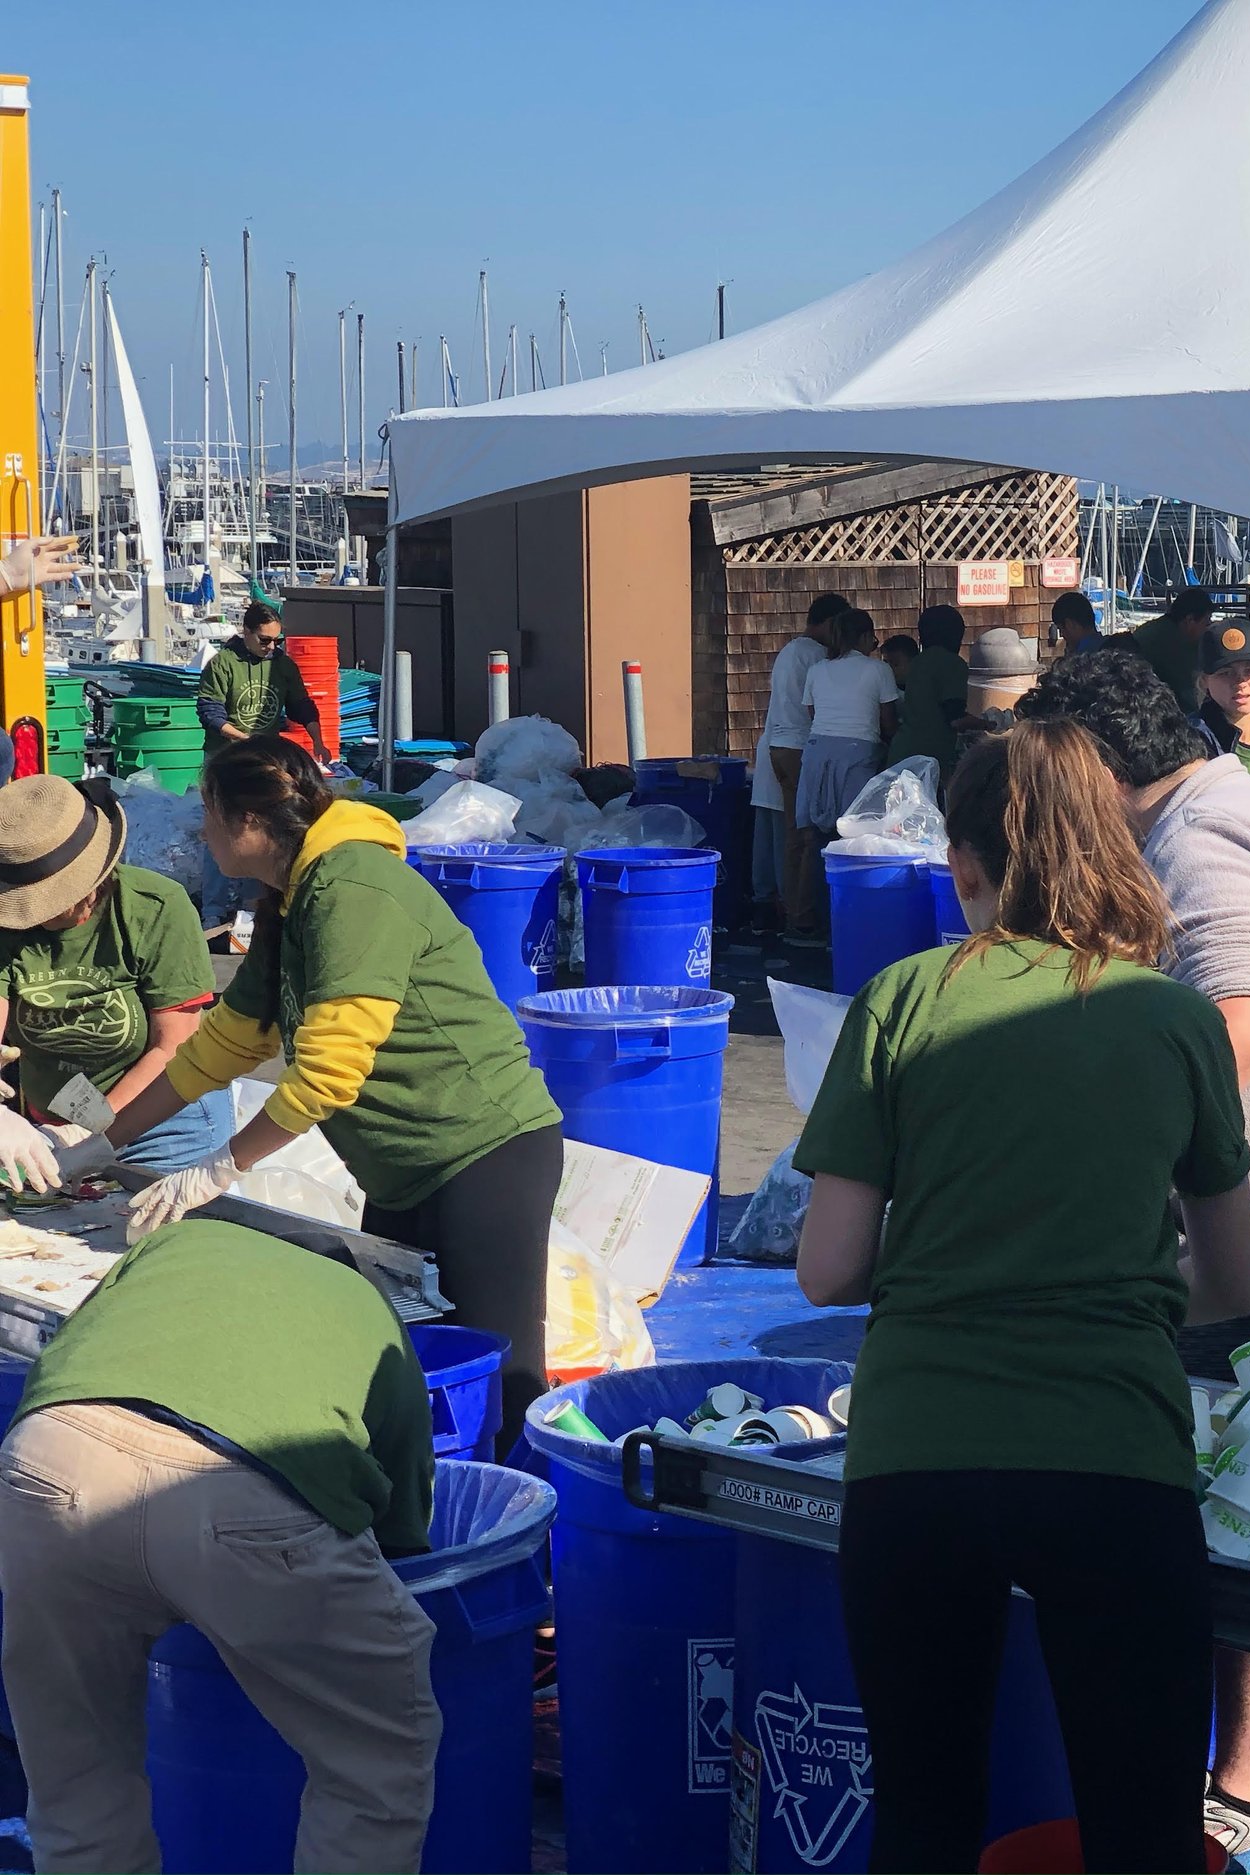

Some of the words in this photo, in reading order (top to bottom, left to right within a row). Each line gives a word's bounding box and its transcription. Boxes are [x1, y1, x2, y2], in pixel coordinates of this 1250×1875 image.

[971, 569, 997, 580] PLEASE
[961, 584, 970, 595] NO
[973, 584, 1006, 595] GASOLINE
[20, 967, 68, 984] GREEN
[77, 966, 111, 988] TEAM
[764, 1491, 802, 1512] RAMP
[807, 1501, 838, 1522] CAP.
[774, 1729, 867, 1762] RECYCLE
[694, 1763, 726, 1783] We
[801, 1763, 834, 1787] WE
